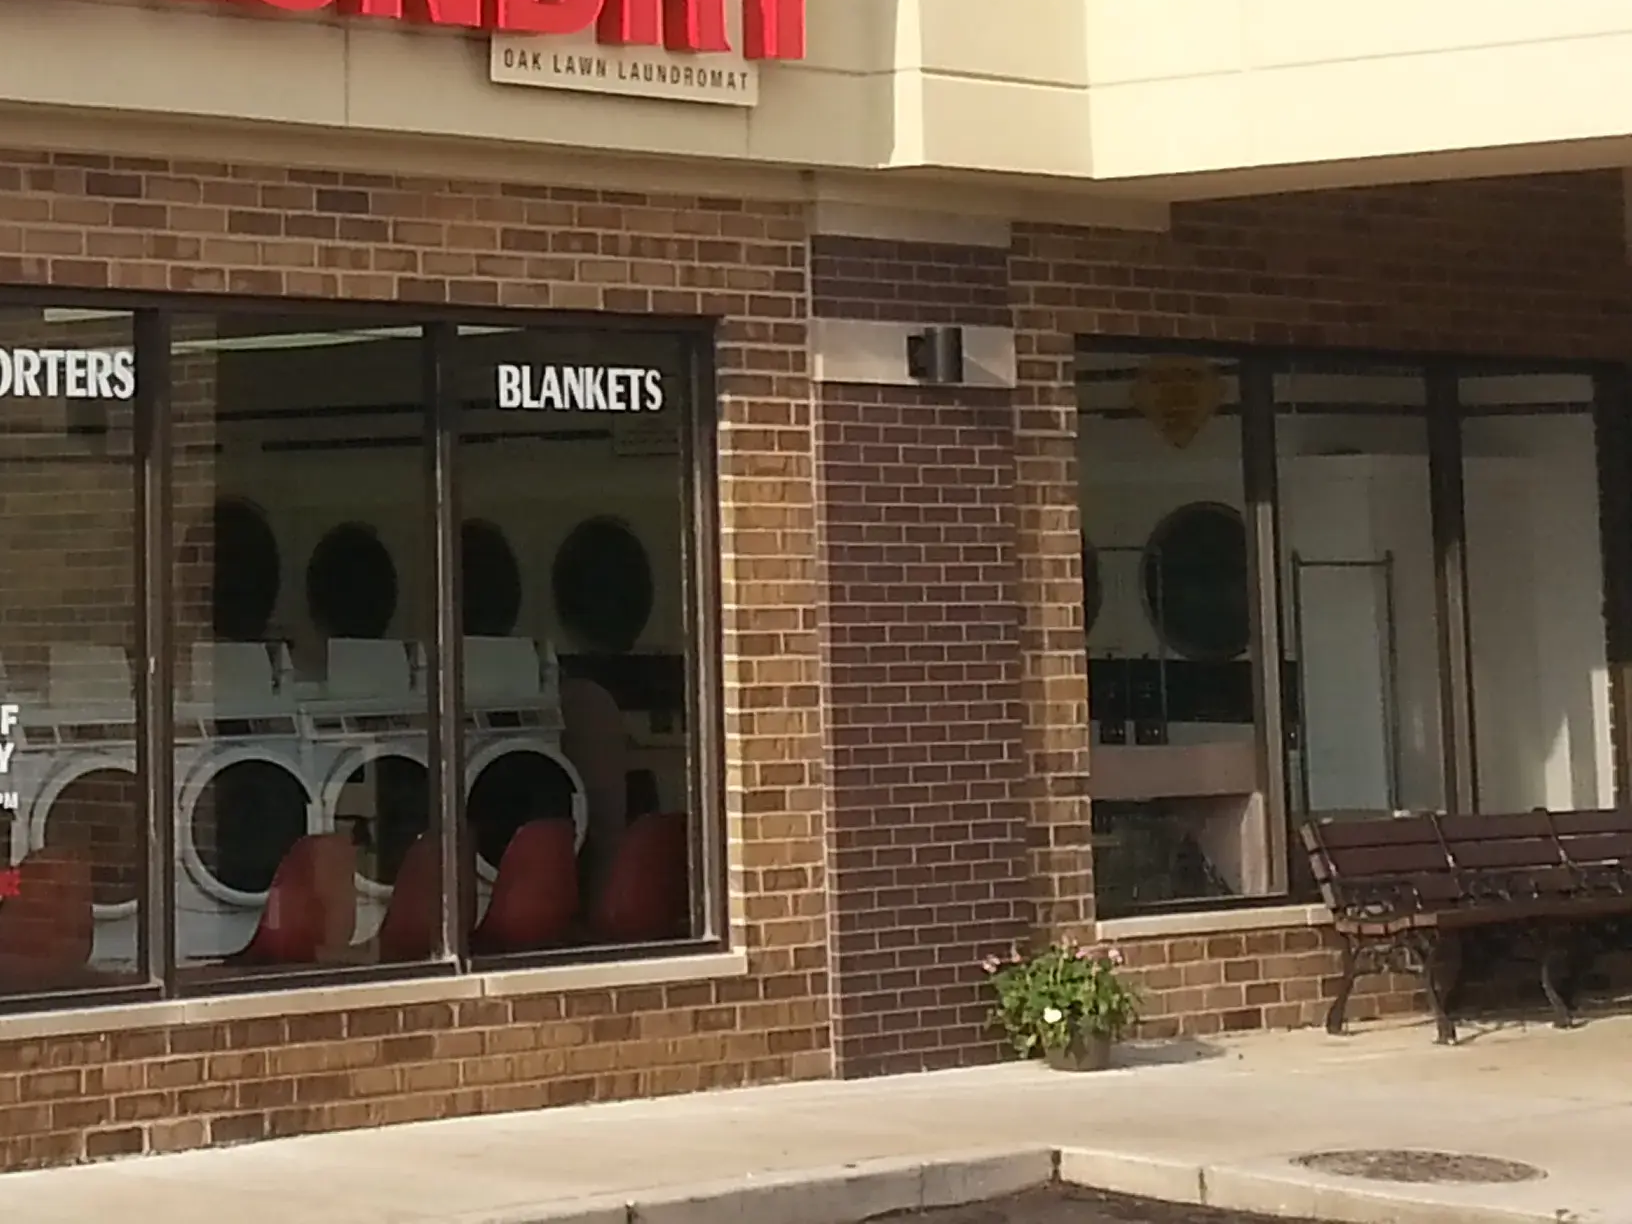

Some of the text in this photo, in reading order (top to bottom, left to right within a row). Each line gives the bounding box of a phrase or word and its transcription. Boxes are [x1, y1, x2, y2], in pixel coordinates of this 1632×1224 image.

[503, 47, 749, 92] OAK LAWN LAUNDROMAT
[497, 365, 663, 412] BLANKETS
